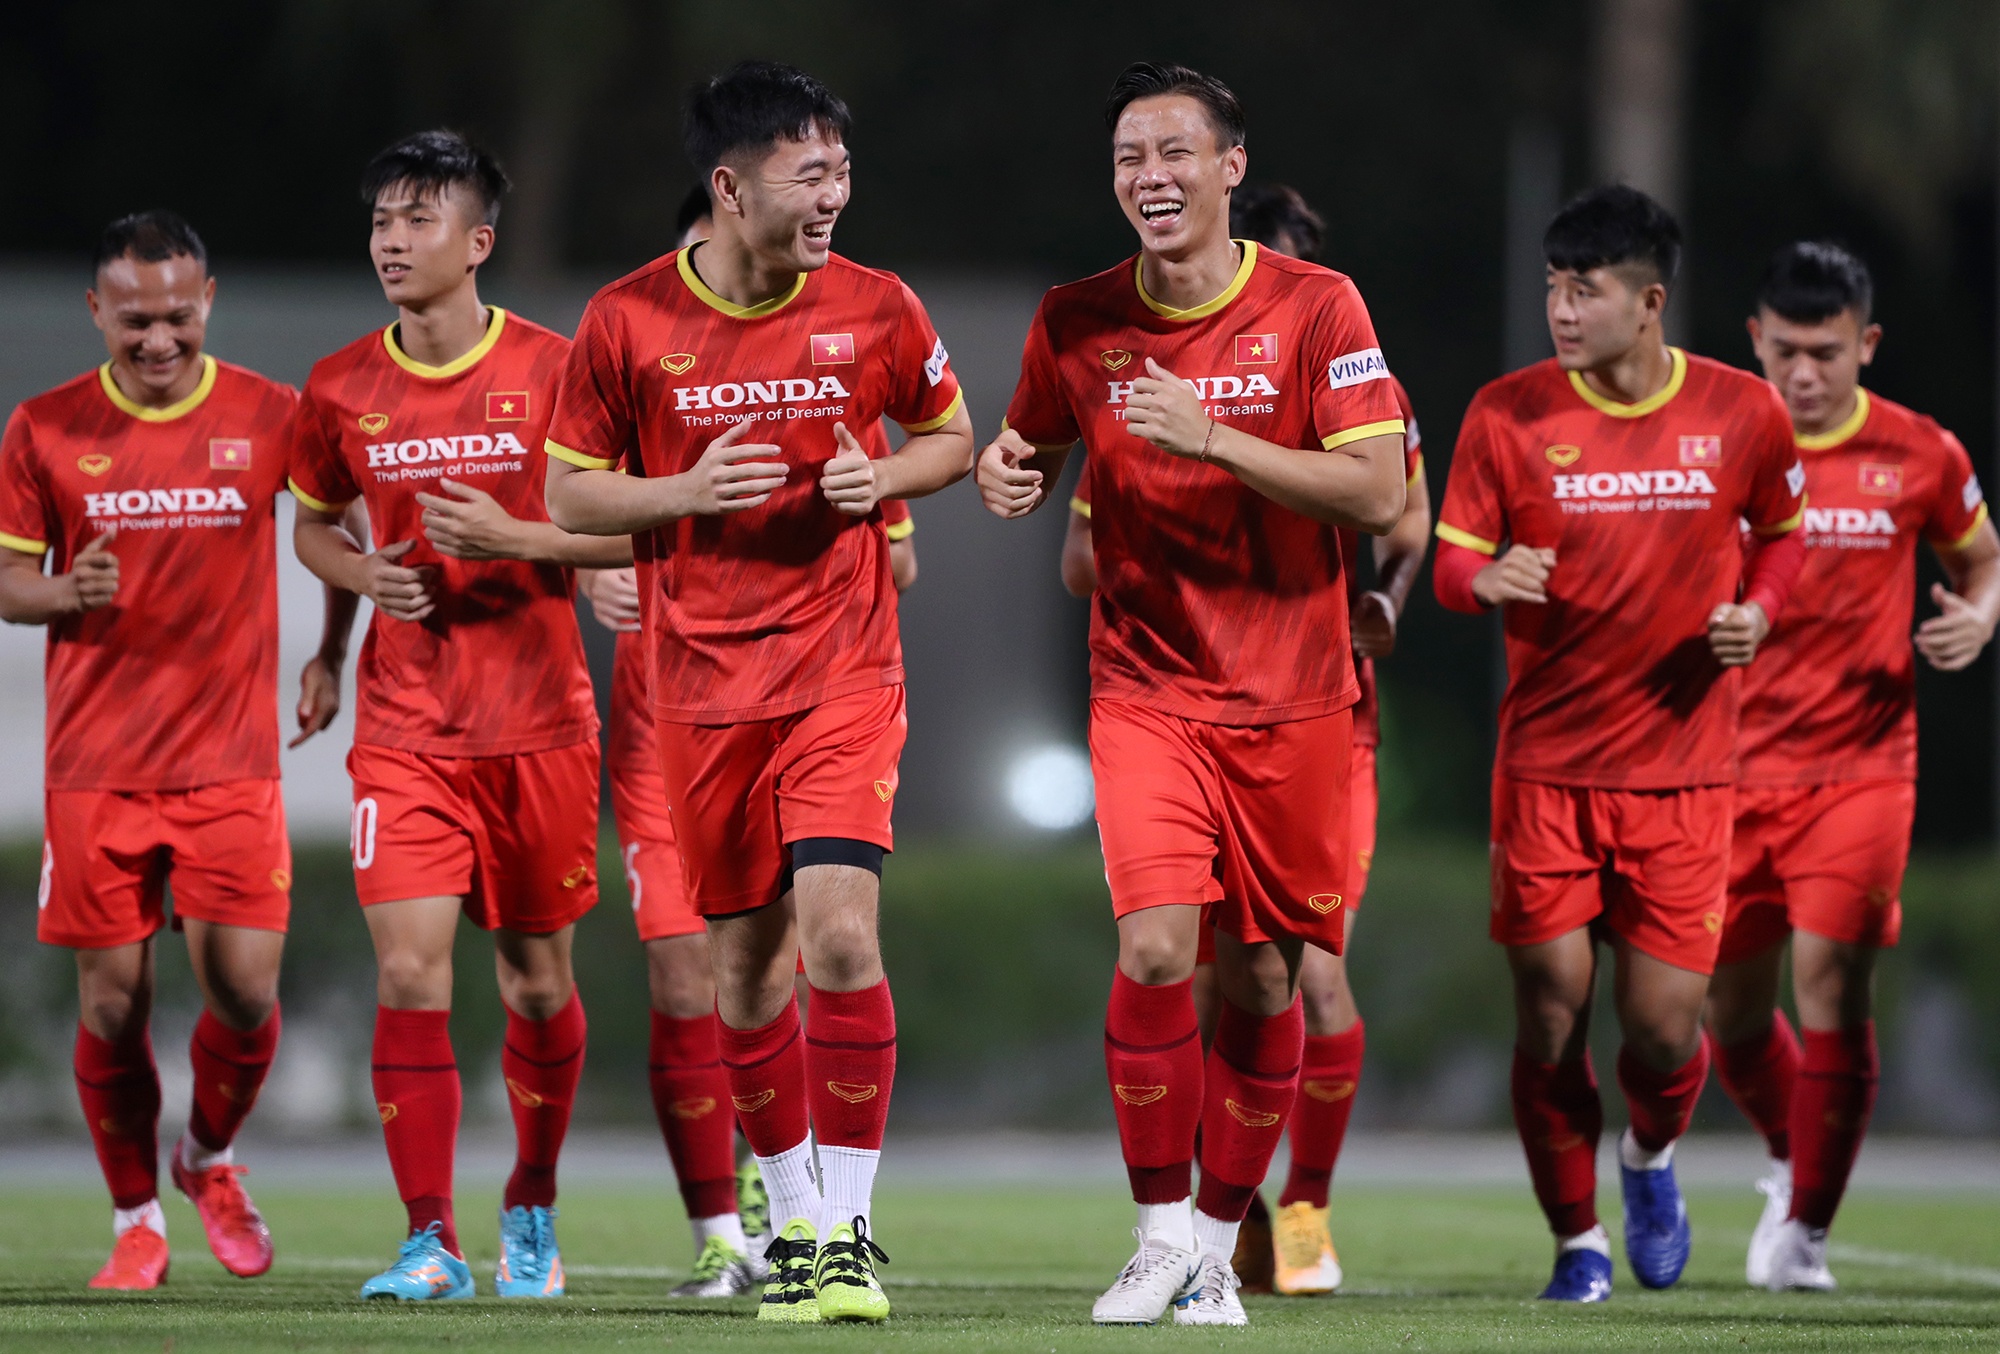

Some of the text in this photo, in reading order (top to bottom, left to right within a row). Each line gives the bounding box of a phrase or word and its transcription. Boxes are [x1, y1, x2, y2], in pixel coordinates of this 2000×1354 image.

[673, 376, 850, 411] HONDA
[1106, 373, 1280, 404] HNDA
[682, 405, 844, 428] The Power of Dreams
[1214, 403, 1274, 417] Dreams
[365, 432, 528, 468] HONDA
[374, 460, 522, 483] The Power of Dreams
[1552, 469, 1718, 499] HONDA
[83, 487, 248, 517] HONDA
[1561, 496, 1712, 515] The Power of Dreams
[92, 514, 242, 531] The Power of Dreams
[1804, 507, 1898, 534] NDA
[350, 797, 378, 869] 0
